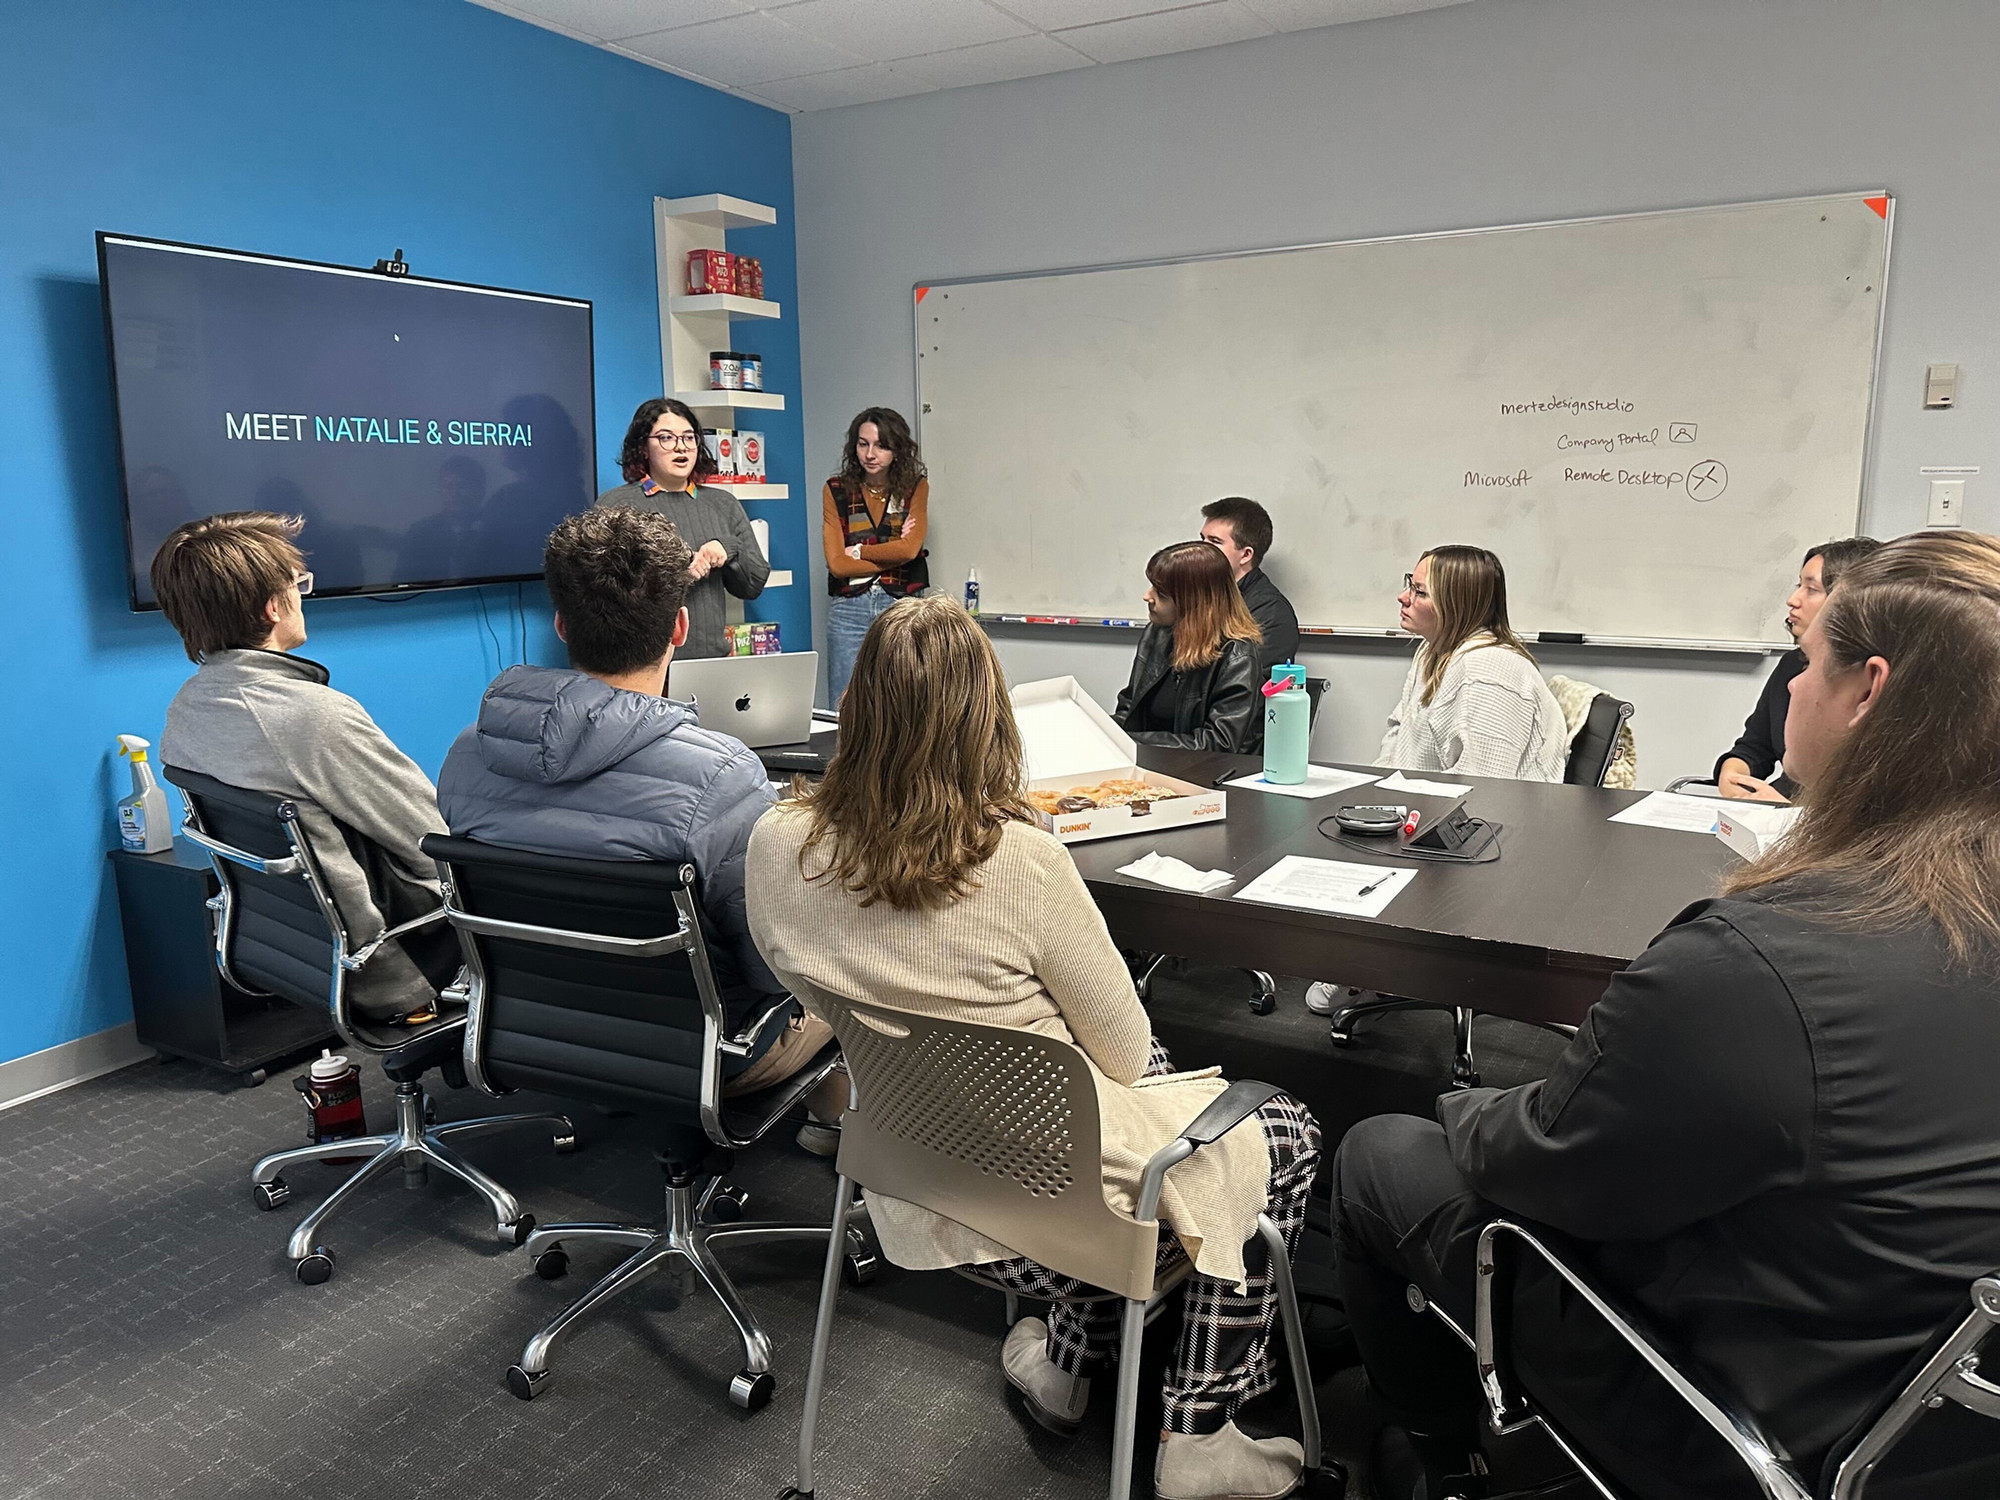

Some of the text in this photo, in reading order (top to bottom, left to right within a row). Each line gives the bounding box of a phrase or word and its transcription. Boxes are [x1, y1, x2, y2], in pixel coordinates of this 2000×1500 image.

[226, 412, 532, 447] MEET NATALIE & SIERRA!
[1557, 427, 1659, 453] Company Portal
[1463, 467, 1684, 490] Microsoft Remote Desktop
